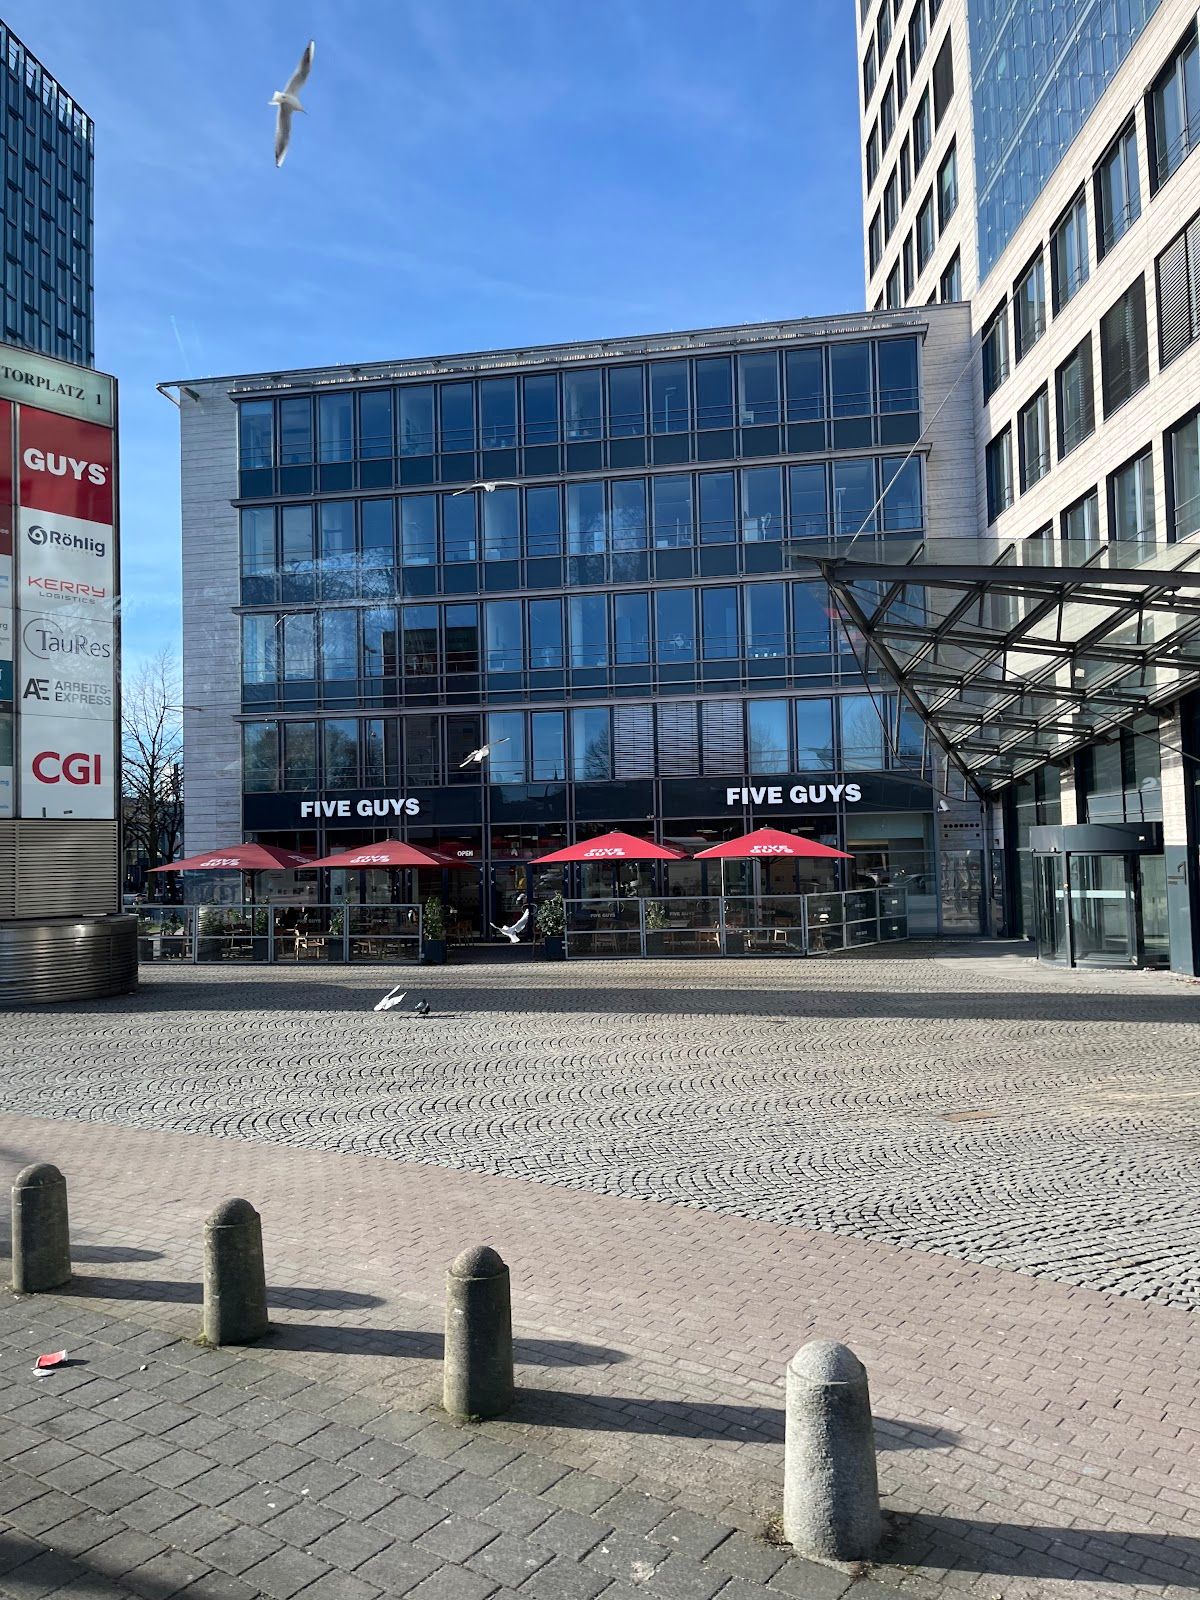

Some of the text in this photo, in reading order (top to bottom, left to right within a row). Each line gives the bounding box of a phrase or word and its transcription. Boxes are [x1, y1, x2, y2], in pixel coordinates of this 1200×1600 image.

[96, 394, 102, 405] 1
[24, 448, 106, 485] GUYS
[50, 530, 105, 557] Röhlig
[28, 576, 105, 598] KERRY
[39, 591, 96, 605] LOGISTICS
[35, 629, 111, 658] TauRes
[55, 692, 111, 706] EXPRESS
[32, 751, 101, 785] CGI
[726, 783, 862, 805] FIVE GUYS
[301, 798, 420, 817] FIVE GUYS
